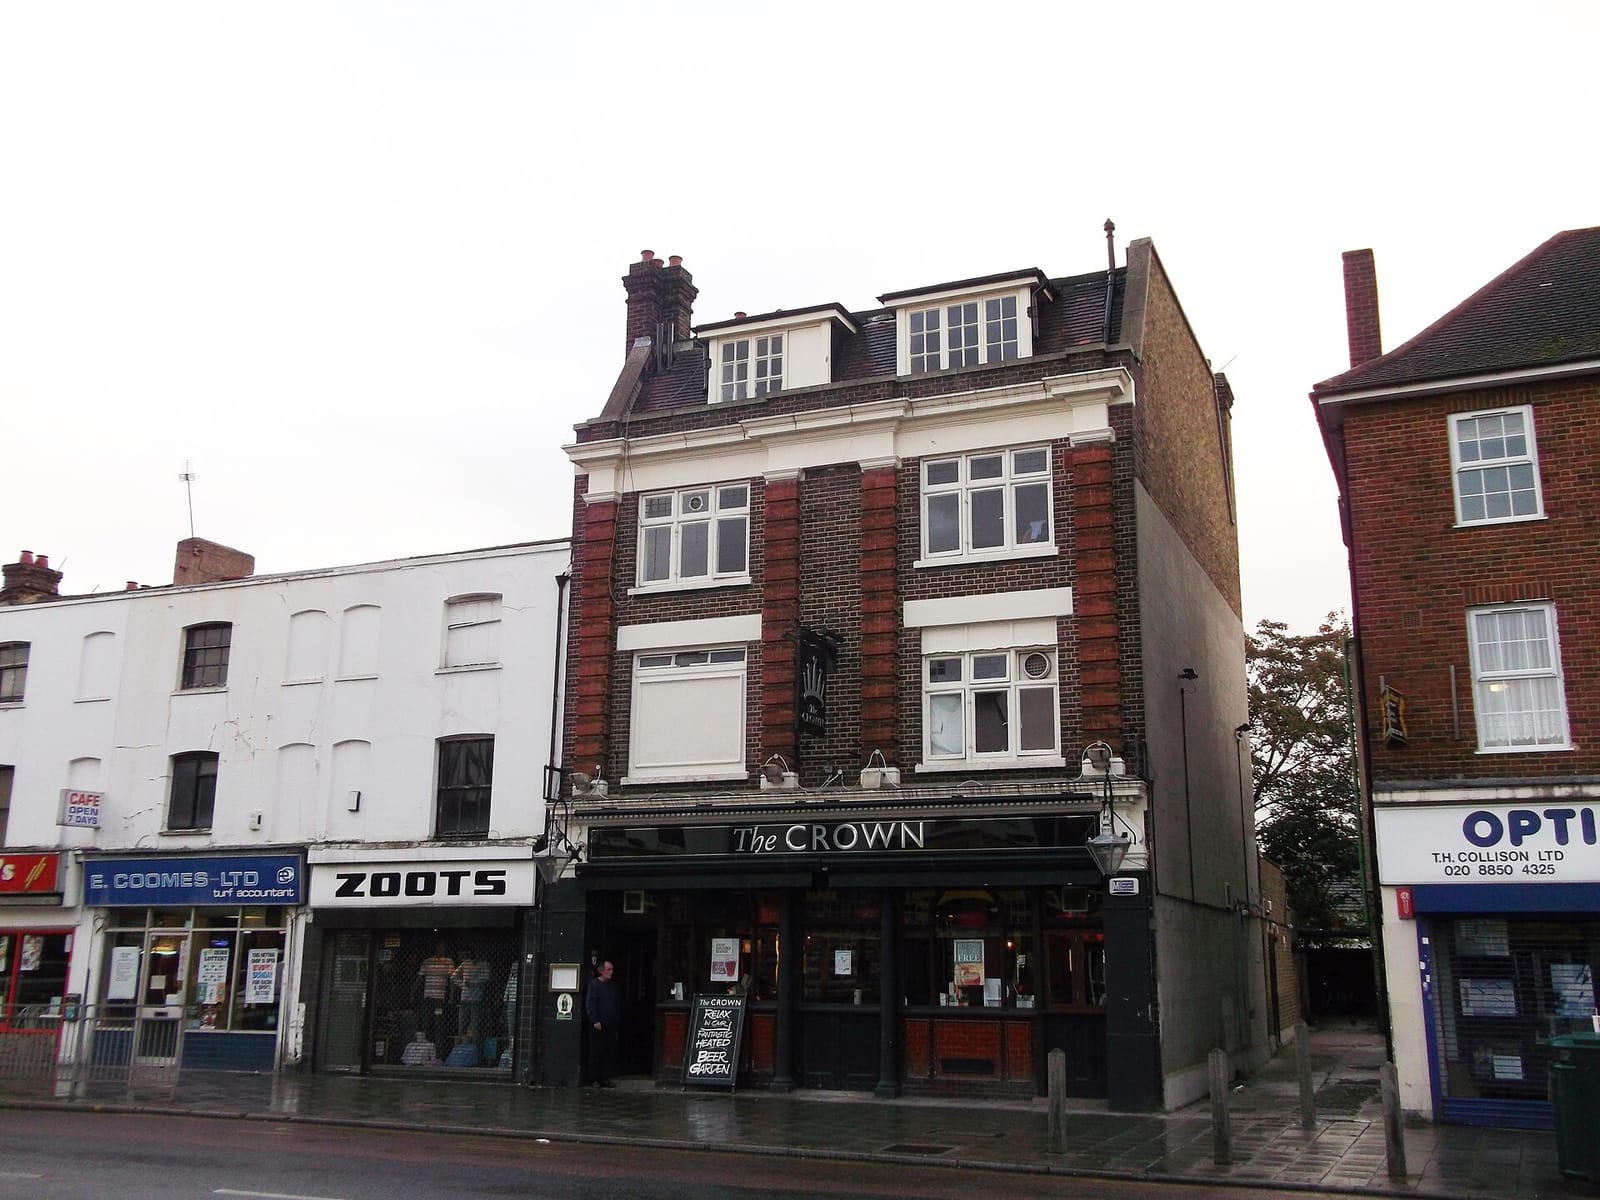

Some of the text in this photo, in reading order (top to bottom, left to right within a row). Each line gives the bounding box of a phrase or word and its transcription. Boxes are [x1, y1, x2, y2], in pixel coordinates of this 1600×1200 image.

[70, 793, 100, 806] CAFE
[69, 806, 98, 815] OPEN
[75, 815, 97, 824] DAYS
[1462, 807, 1597, 848] OPTI
[733, 822, 925, 854] The CROWN
[1431, 850, 1564, 863] T.H. COLLISON LTD
[1444, 863, 1555, 876] 020 8850 4325
[90, 871, 259, 889] E. COOMES LTD
[335, 870, 507, 898] ZOOTS
[213, 888, 294, 898] turf accountant
[704, 1009, 732, 1019] RELAX
[697, 1030, 733, 1038] FANTASTIC
[696, 1039, 731, 1048] HEATED
[697, 1051, 728, 1063] BEER
[689, 1063, 730, 1075] GARDEN
